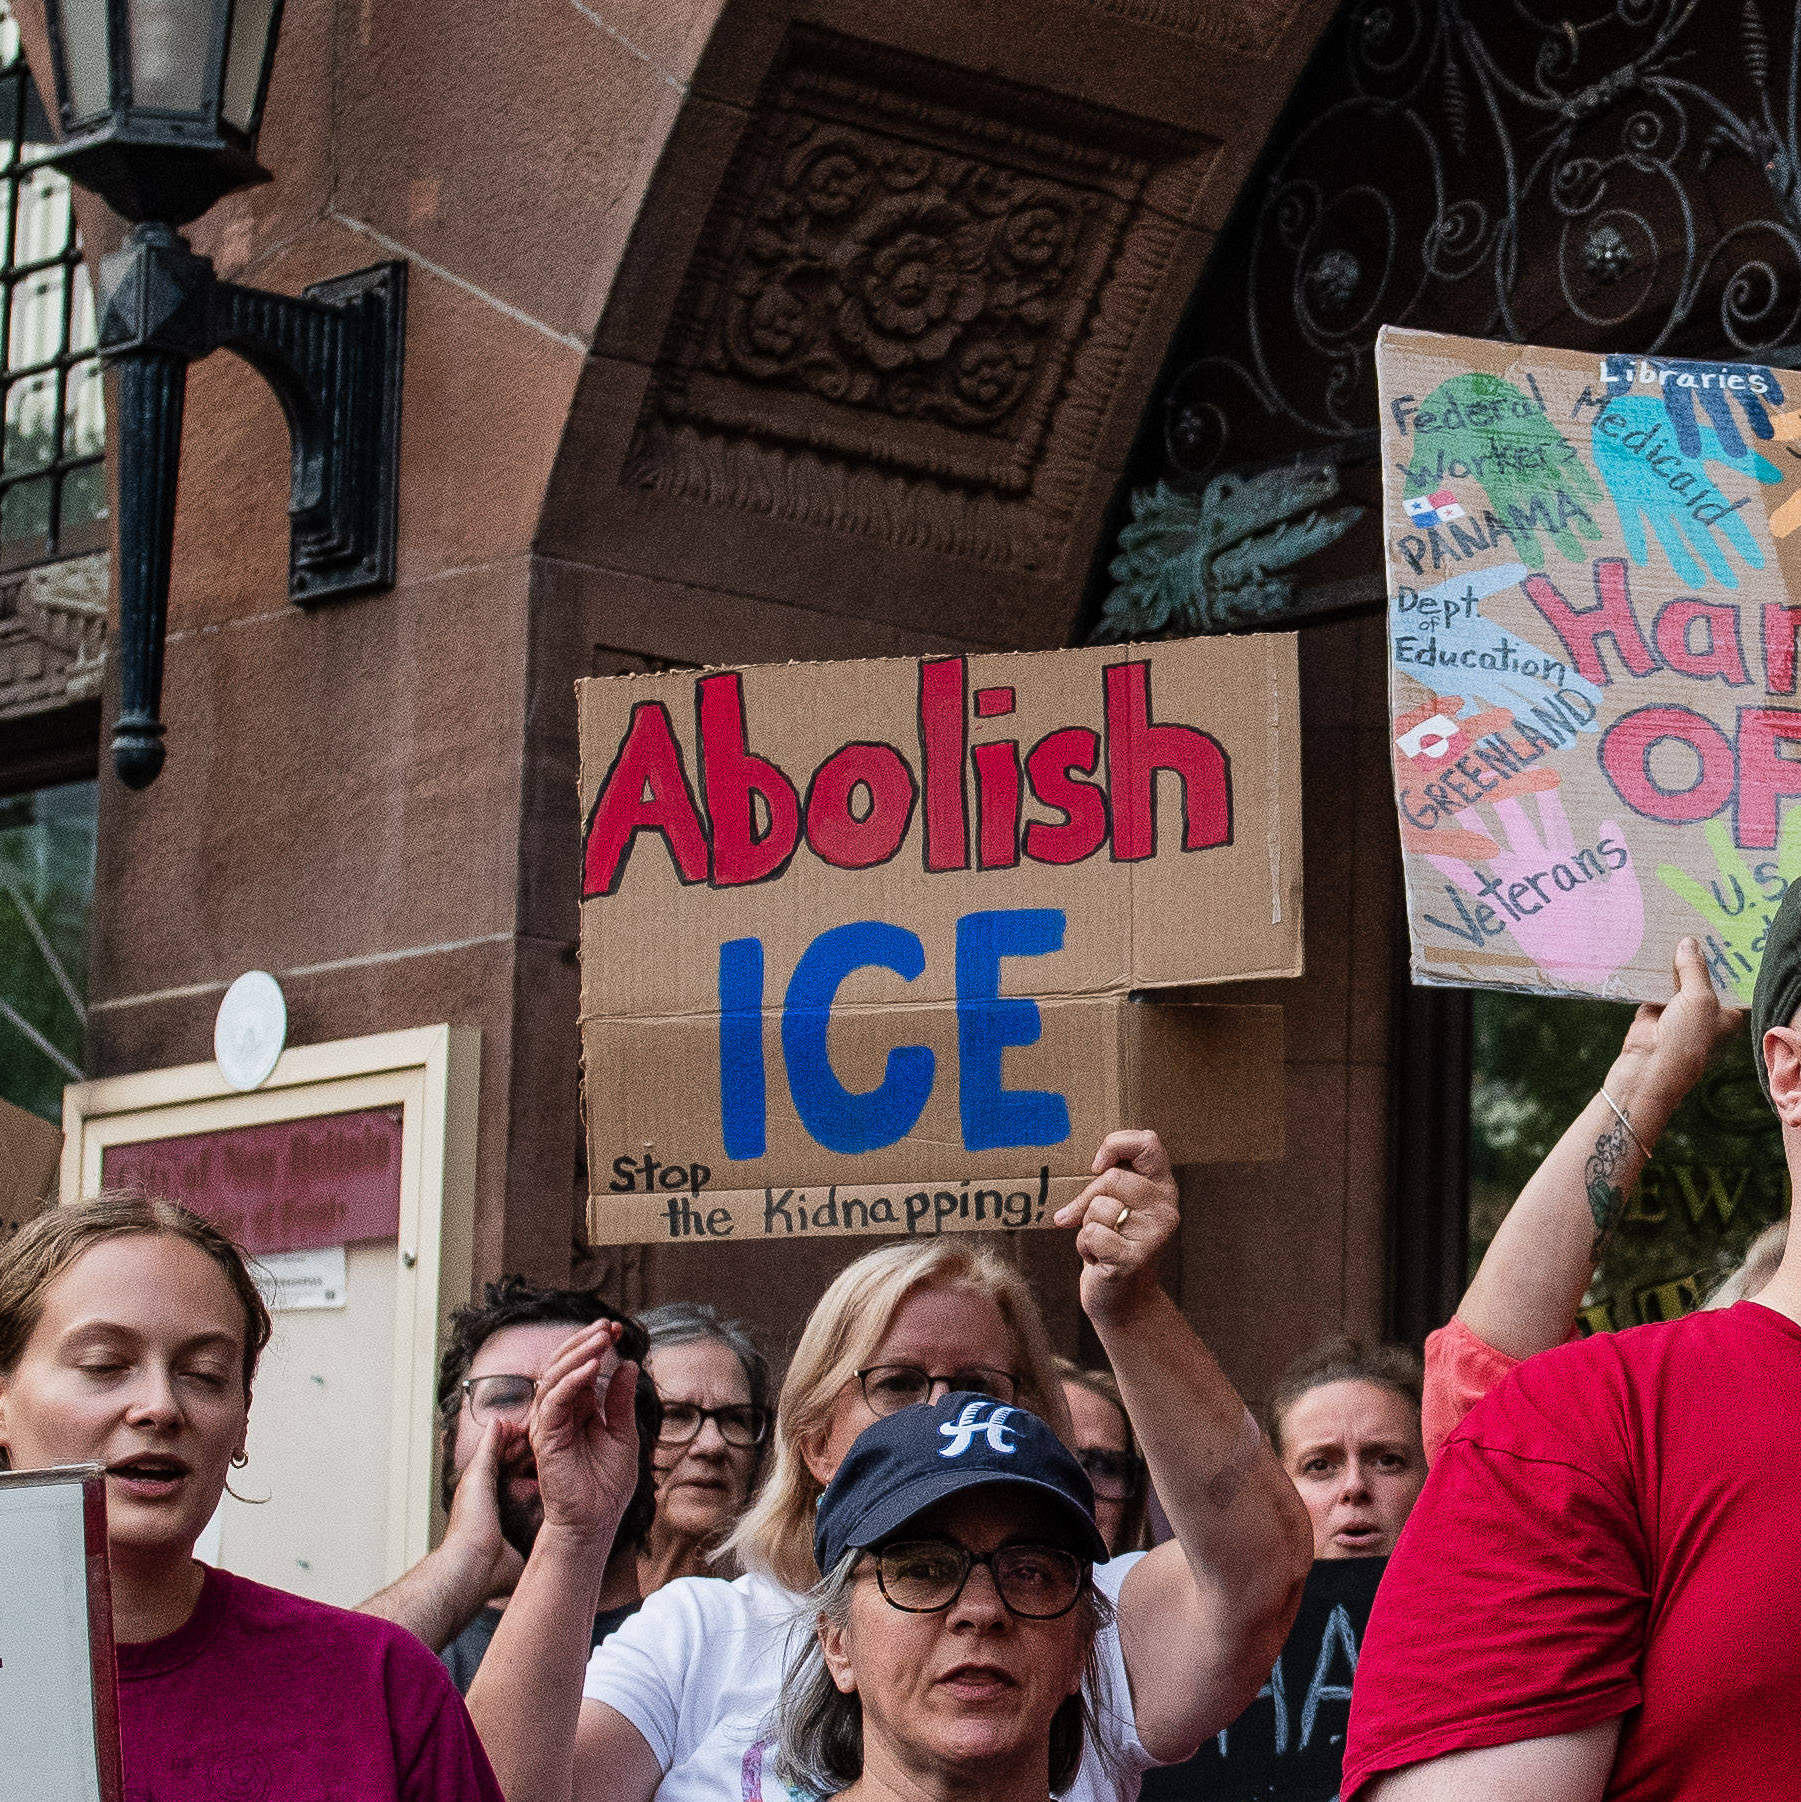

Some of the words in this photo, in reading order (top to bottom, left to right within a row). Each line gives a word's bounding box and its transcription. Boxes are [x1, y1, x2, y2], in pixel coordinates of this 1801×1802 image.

[1391, 372, 1548, 437] Federal
[1599, 359, 1771, 394] Libraries
[1397, 436, 1578, 490] Workers
[1570, 384, 1751, 527] Medicaid
[1399, 488, 1593, 576] PANAMA
[1397, 586, 1482, 629] Dept.
[1418, 615, 1441, 633] of
[1395, 637, 1567, 685] Education
[580, 655, 1235, 901] Abolish
[1399, 687, 1598, 833] GREENLAND
[1422, 838, 1629, 949] Veterans
[717, 907, 1071, 1162] ICE
[609, 1152, 712, 1199] Stop
[660, 1196, 735, 1240] the
[763, 1165, 1051, 1235] Kidnapping!
